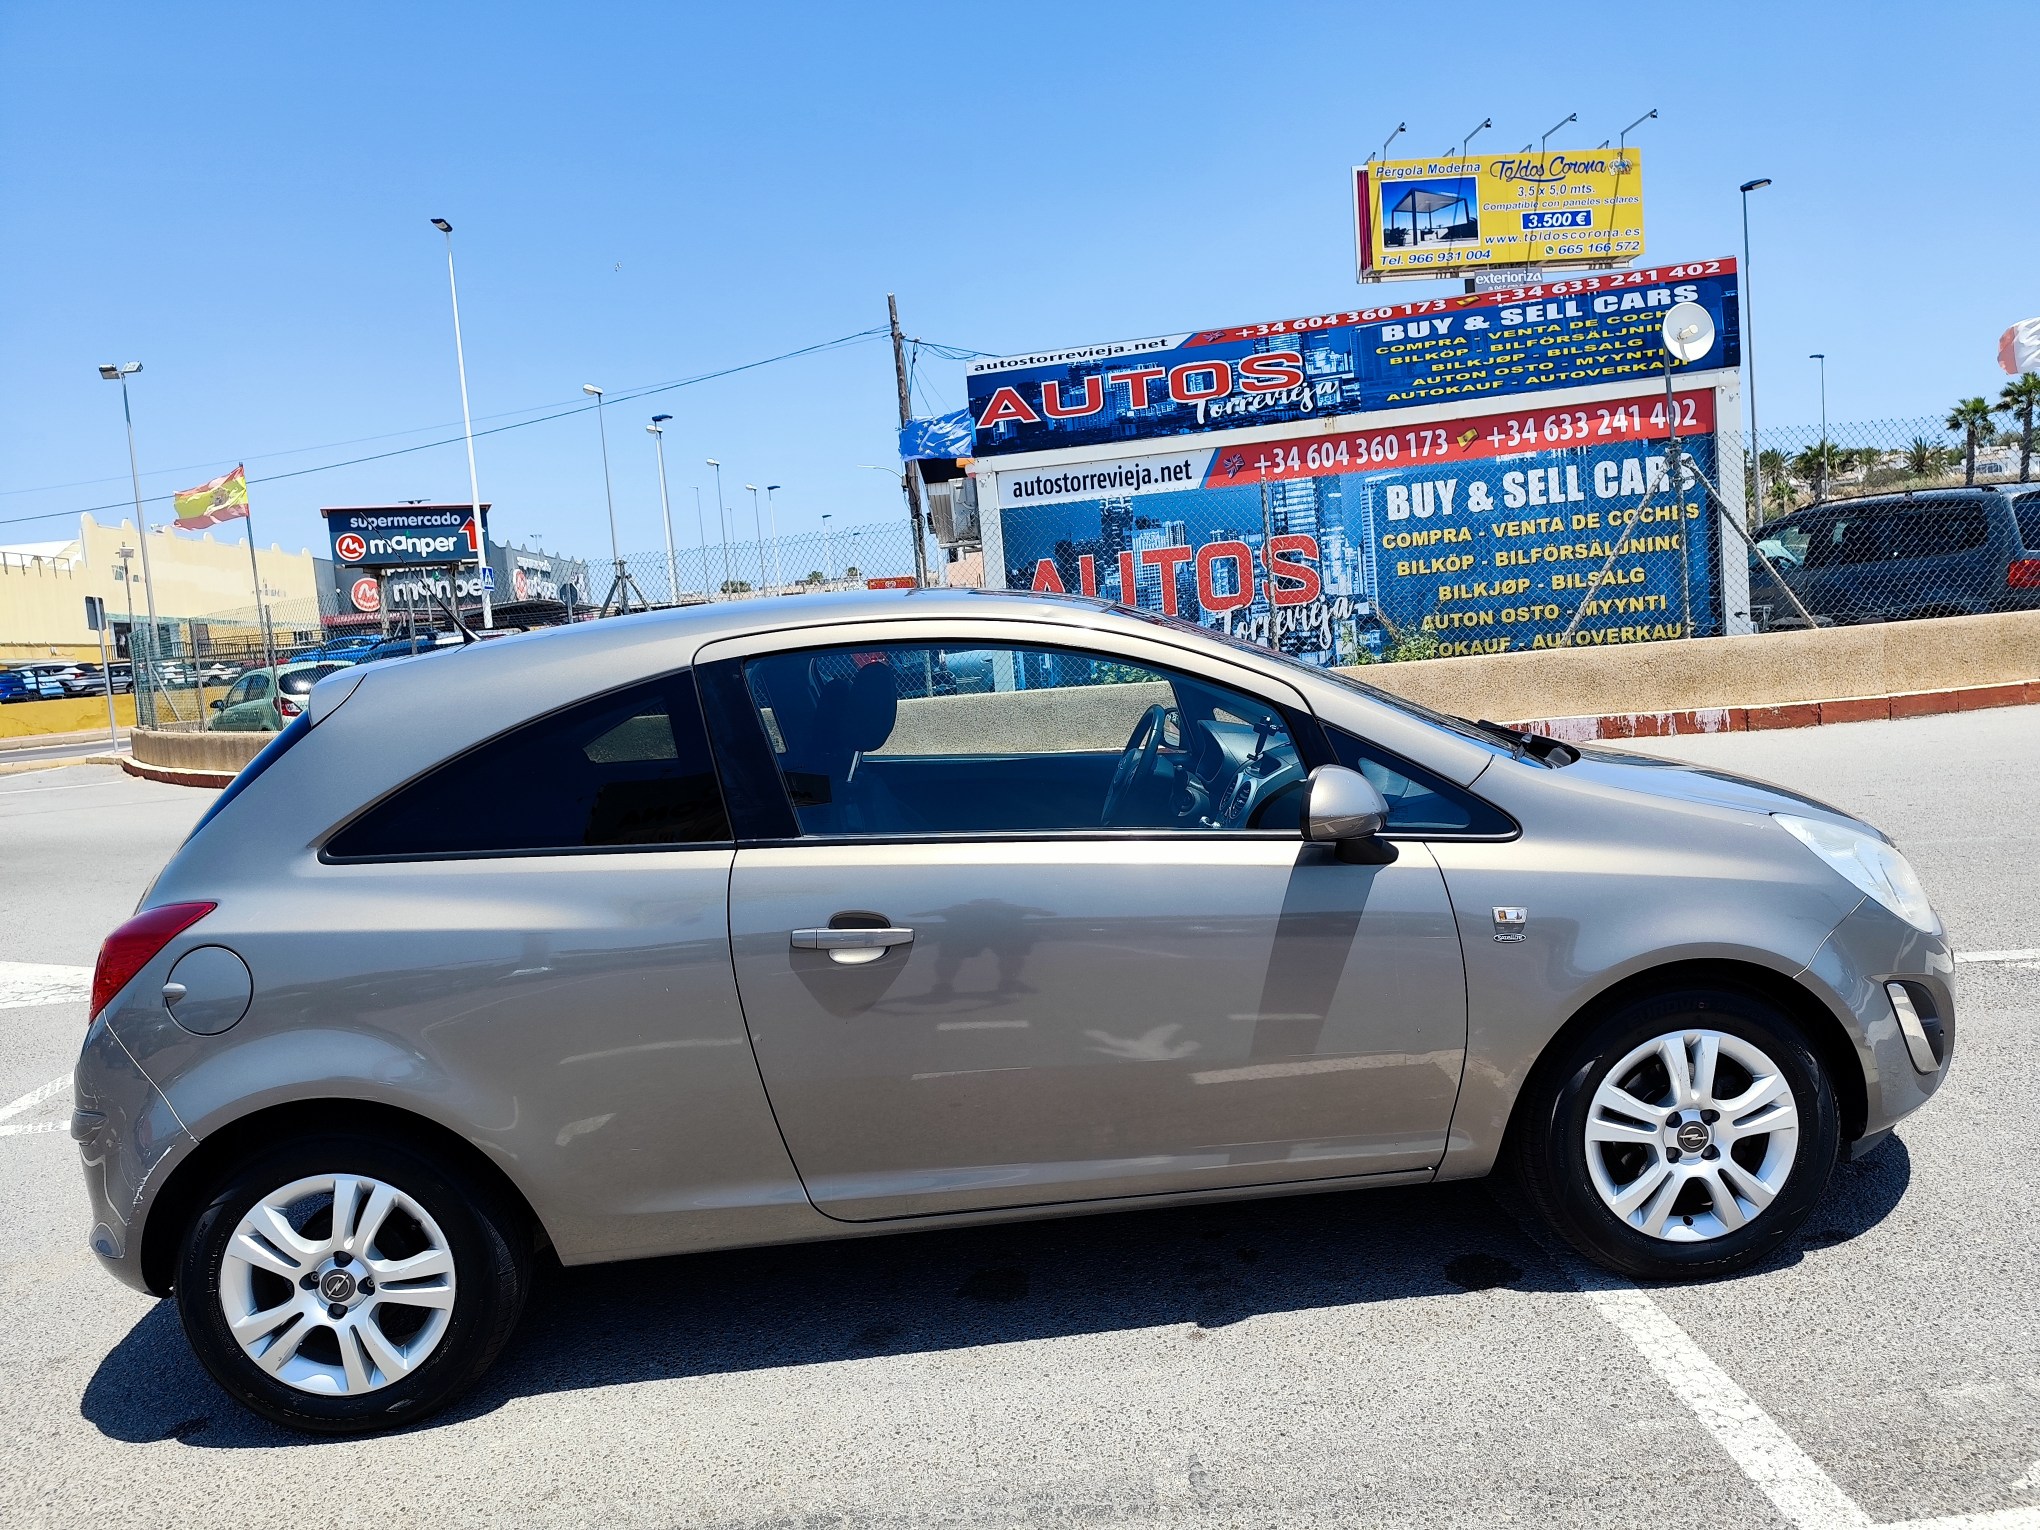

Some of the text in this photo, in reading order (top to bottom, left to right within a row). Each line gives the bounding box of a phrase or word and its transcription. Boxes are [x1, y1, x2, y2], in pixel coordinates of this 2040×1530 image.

[1428, 163, 1480, 175] Moderna
[1550, 156, 1606, 176] Corona
[1483, 195, 1639, 211] Compatible con paneles solares
[1518, 184, 1595, 198] 3,5 x 5,0 mts.
[1528, 212, 1587, 228] 3.500 €
[1485, 228, 1640, 244] www.toldoscorona.es
[1558, 241, 1640, 255] 665 166 572
[1380, 250, 1491, 266] Tel. 966 931 004
[1475, 270, 1542, 284] exterioriza
[974, 262, 1721, 371] autostorrevieja.net +34 604 360 173 +34 633 241 402
[1381, 285, 1699, 342] BUY & SELL CARS
[1375, 336, 1467, 355] COMPRA
[1487, 324, 1561, 340] VENTA
[1569, 319, 1599, 330] DE
[1606, 310, 1668, 325] COCH
[1389, 348, 1469, 365] BILKÖP
[1490, 323, 1664, 352] BILFÖRSÄLJNIN
[1412, 370, 1487, 386] AUTON
[1494, 361, 1554, 376] OSTO
[1576, 348, 1665, 366] MYYNTI
[1431, 353, 1526, 372] BILKJØP
[1547, 338, 1644, 357] BILSALG
[976, 351, 1303, 429] AUTOS
[1188, 380, 1338, 424] Torrevieja
[1386, 380, 1504, 402] AUTOKAUF
[1013, 399, 1697, 498] autostorrevieja.net +34 604 360 173 +34 633 241 402
[1386, 452, 1695, 521] BUY & SELL CARS
[350, 512, 460, 528] supermercado
[1382, 526, 1472, 549] COMPRA
[1492, 517, 1564, 538] VENTA
[1572, 513, 1600, 530] DE
[369, 532, 457, 557] manper
[1397, 554, 1475, 576] BILKÖP
[393, 577, 484, 602] manpe
[1439, 578, 1530, 601] BILKJØP
[1552, 567, 1645, 590] BILSALG
[1421, 610, 1494, 631] AUTON
[1501, 604, 1559, 623] OSTO
[1582, 595, 1667, 616] MYYNTI
